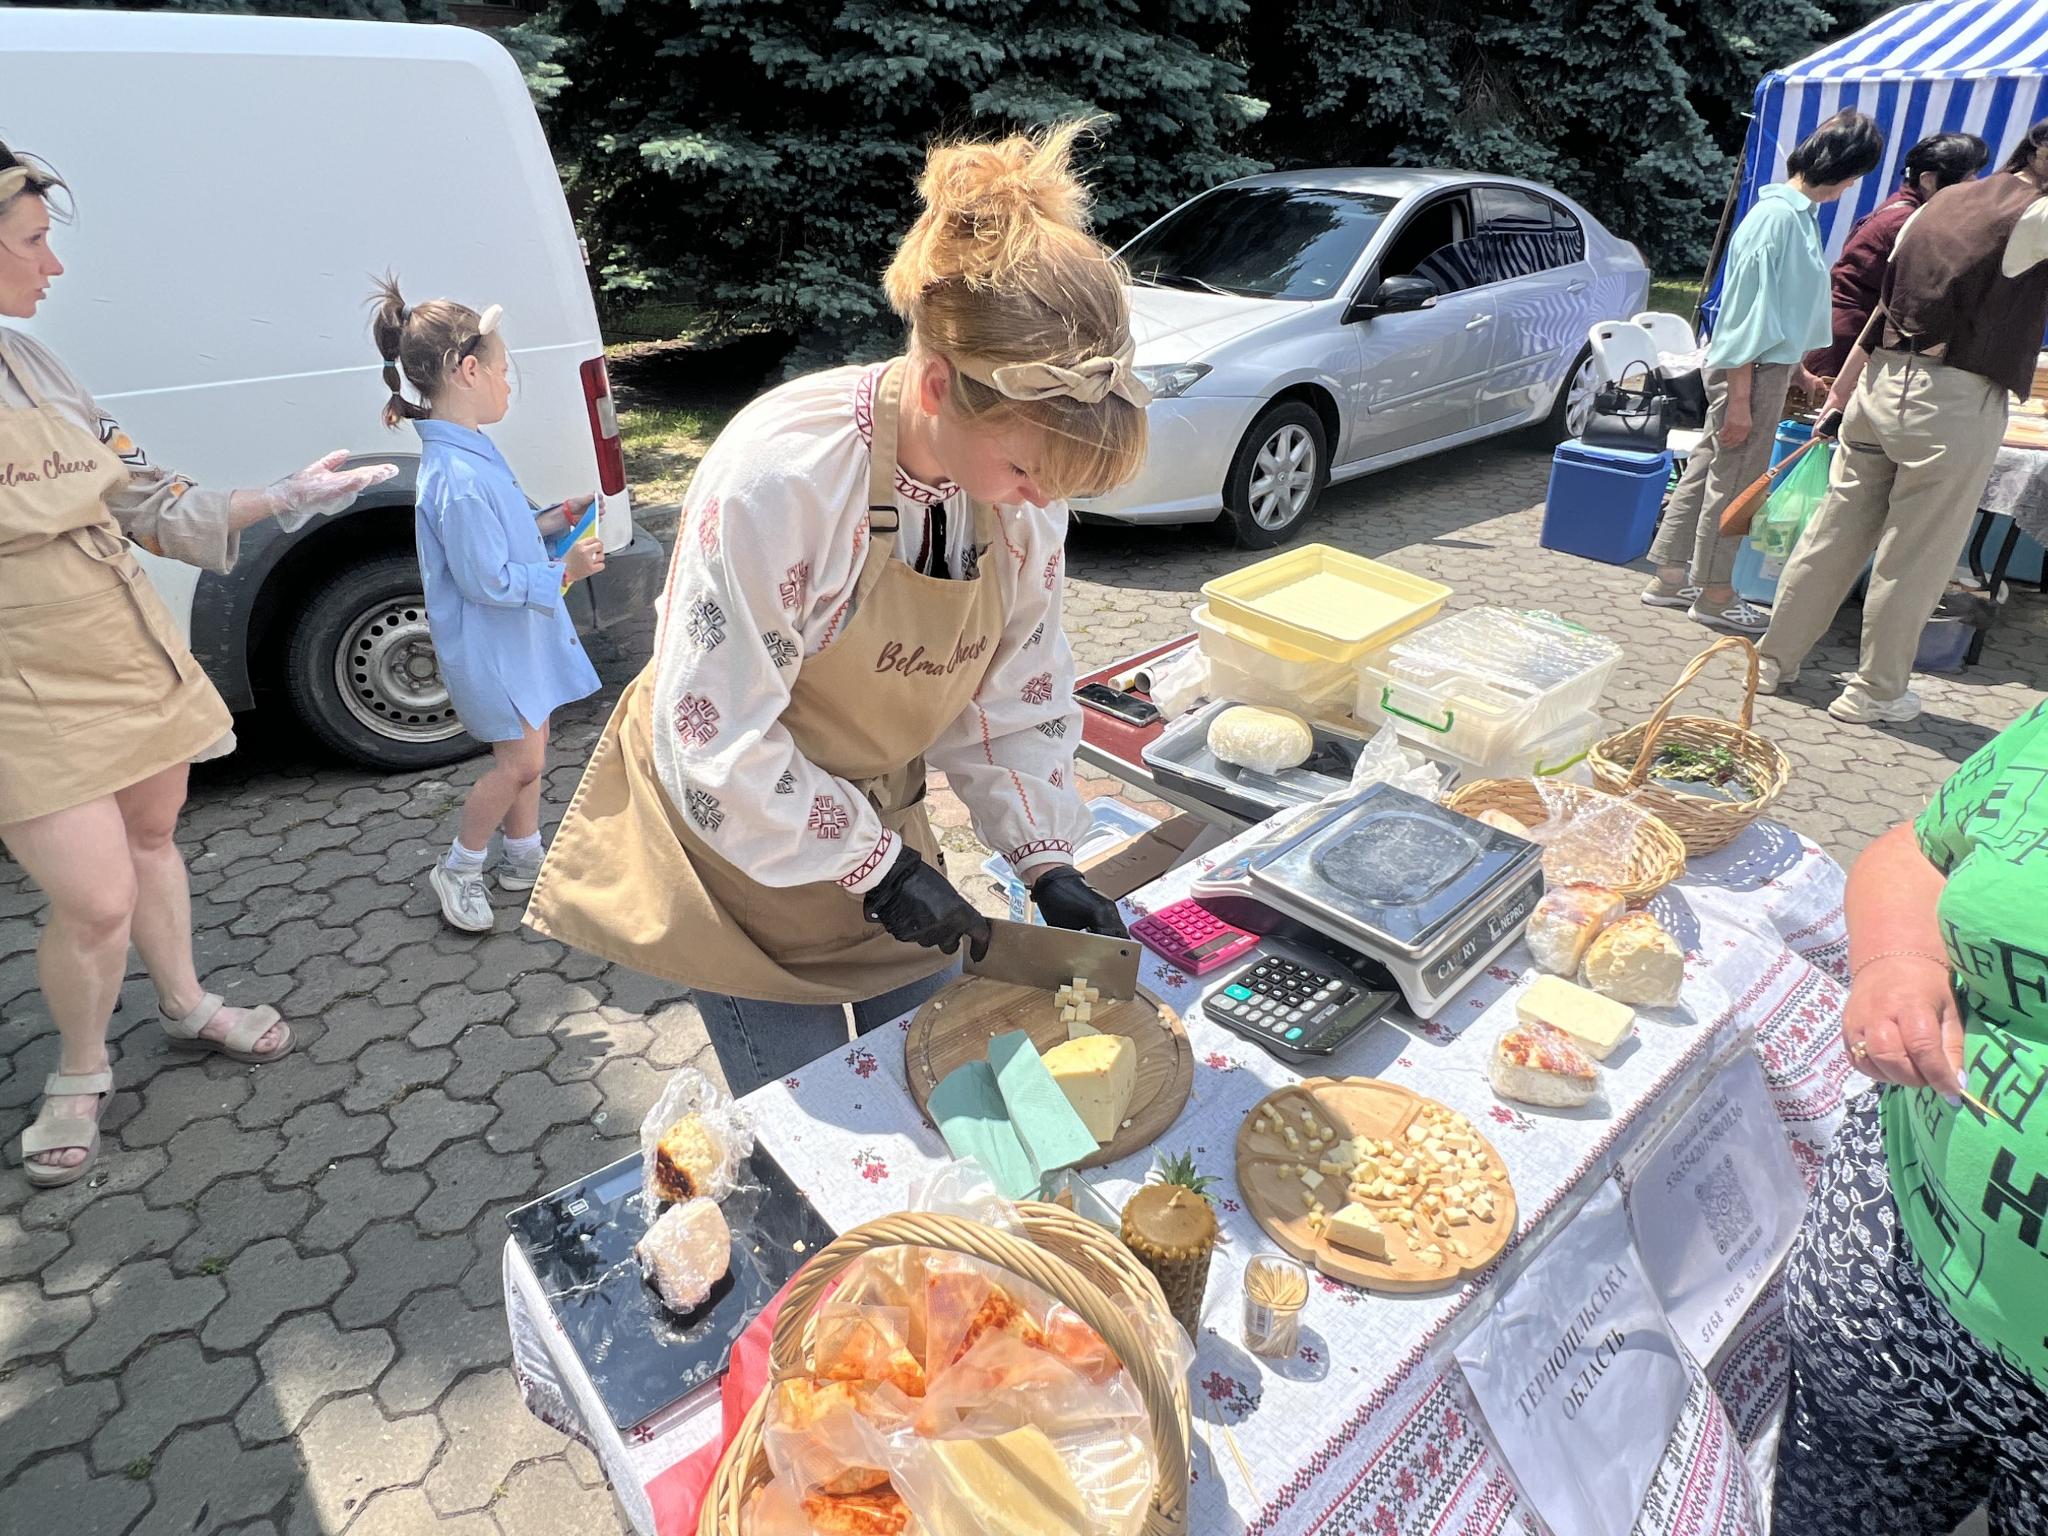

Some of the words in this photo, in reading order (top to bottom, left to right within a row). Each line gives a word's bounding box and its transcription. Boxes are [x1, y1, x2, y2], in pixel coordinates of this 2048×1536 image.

[0, 463, 40, 487] elma
[43, 451, 97, 479] Cheese
[874, 641, 945, 677] Belma
[1515, 1263, 1629, 1419] ТЕРНОПІЛЬСЬКА
[1562, 1328, 1626, 1421] ОБЛАСТЬ
